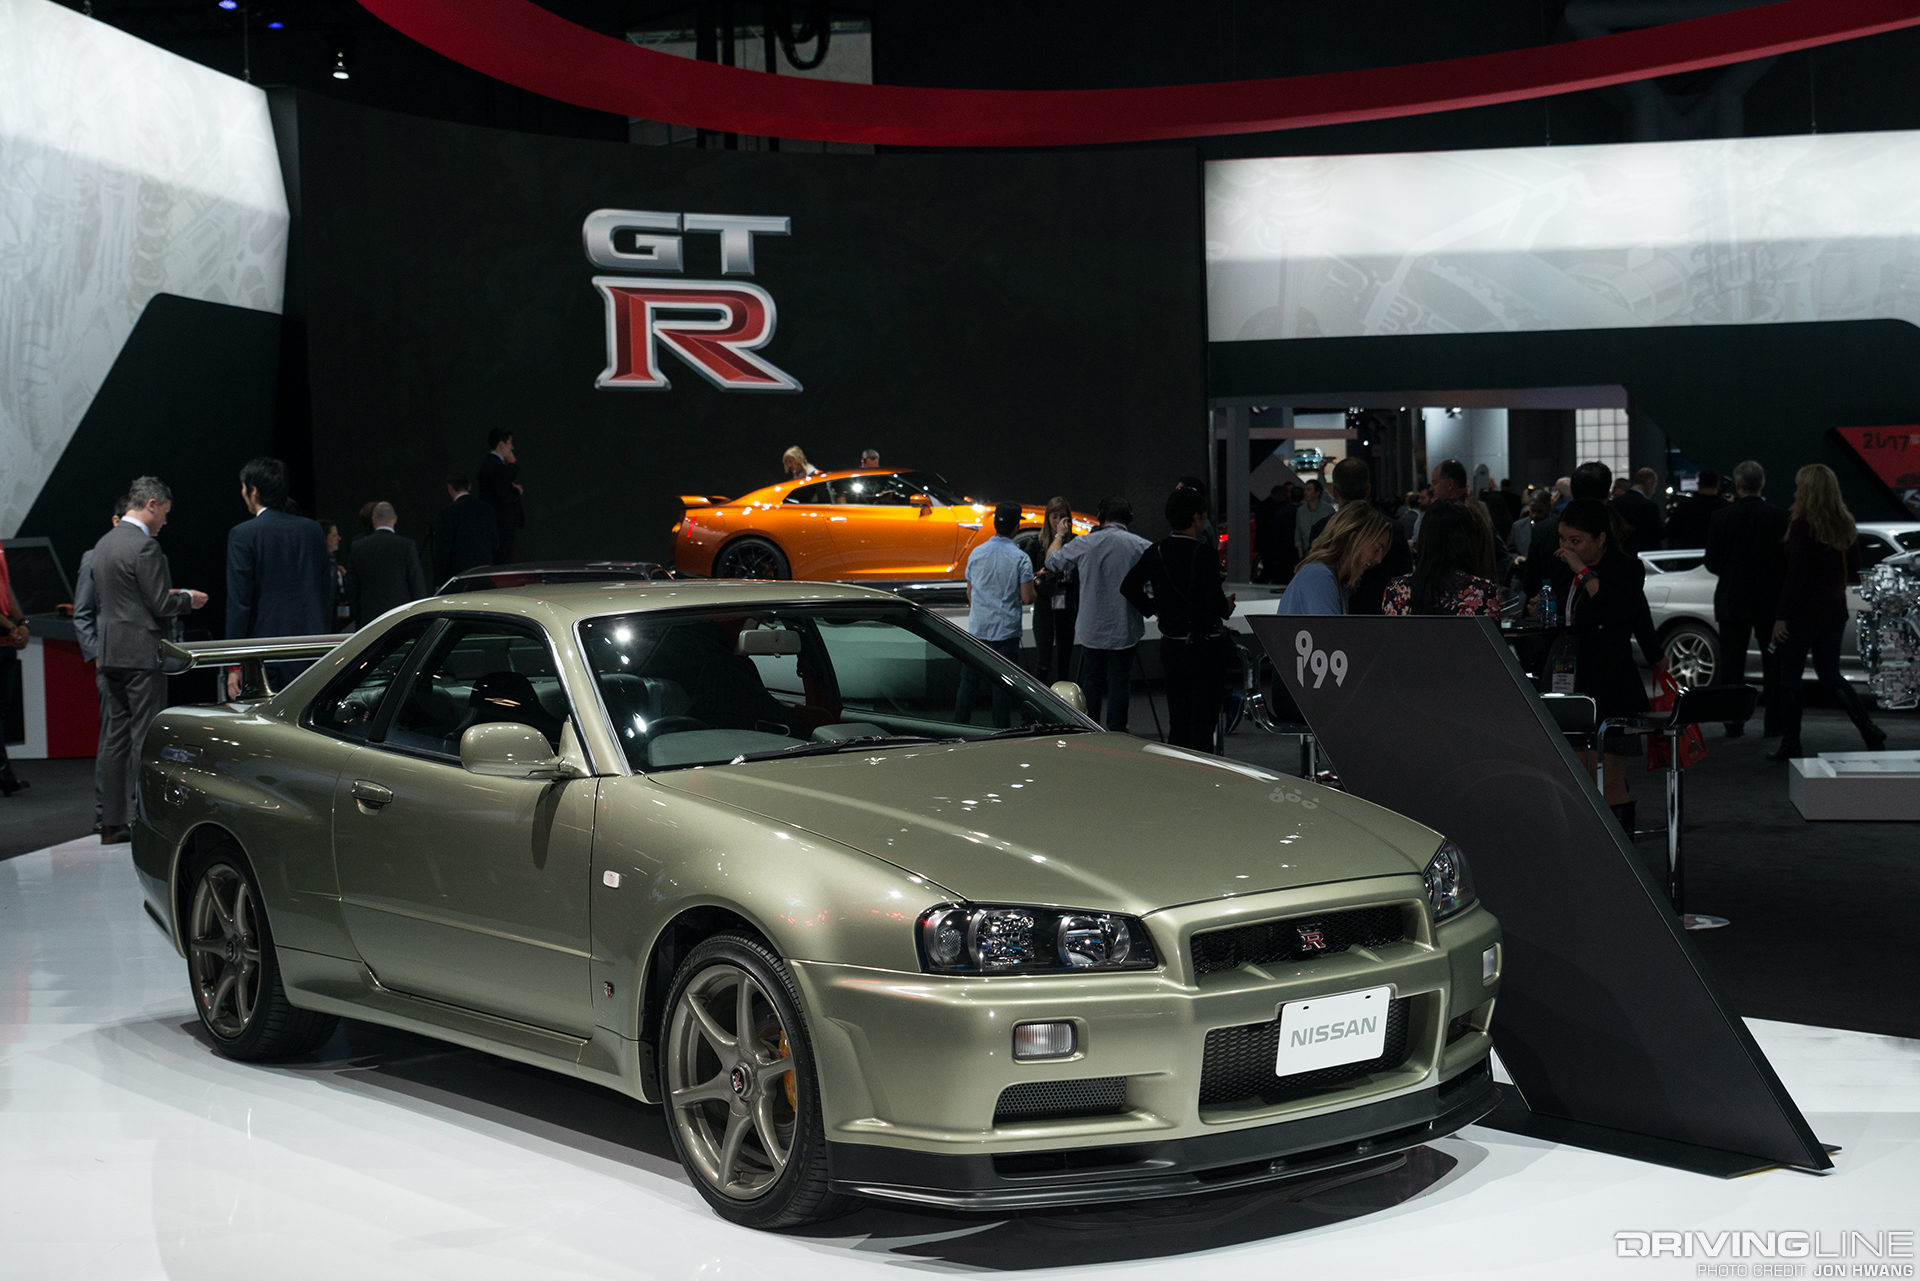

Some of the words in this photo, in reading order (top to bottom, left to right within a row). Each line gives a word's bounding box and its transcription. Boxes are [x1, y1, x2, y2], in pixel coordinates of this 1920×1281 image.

[582, 208, 791, 276] GT
[591, 276, 803, 393] R
[1290, 1016, 1377, 1047] NISSAN
